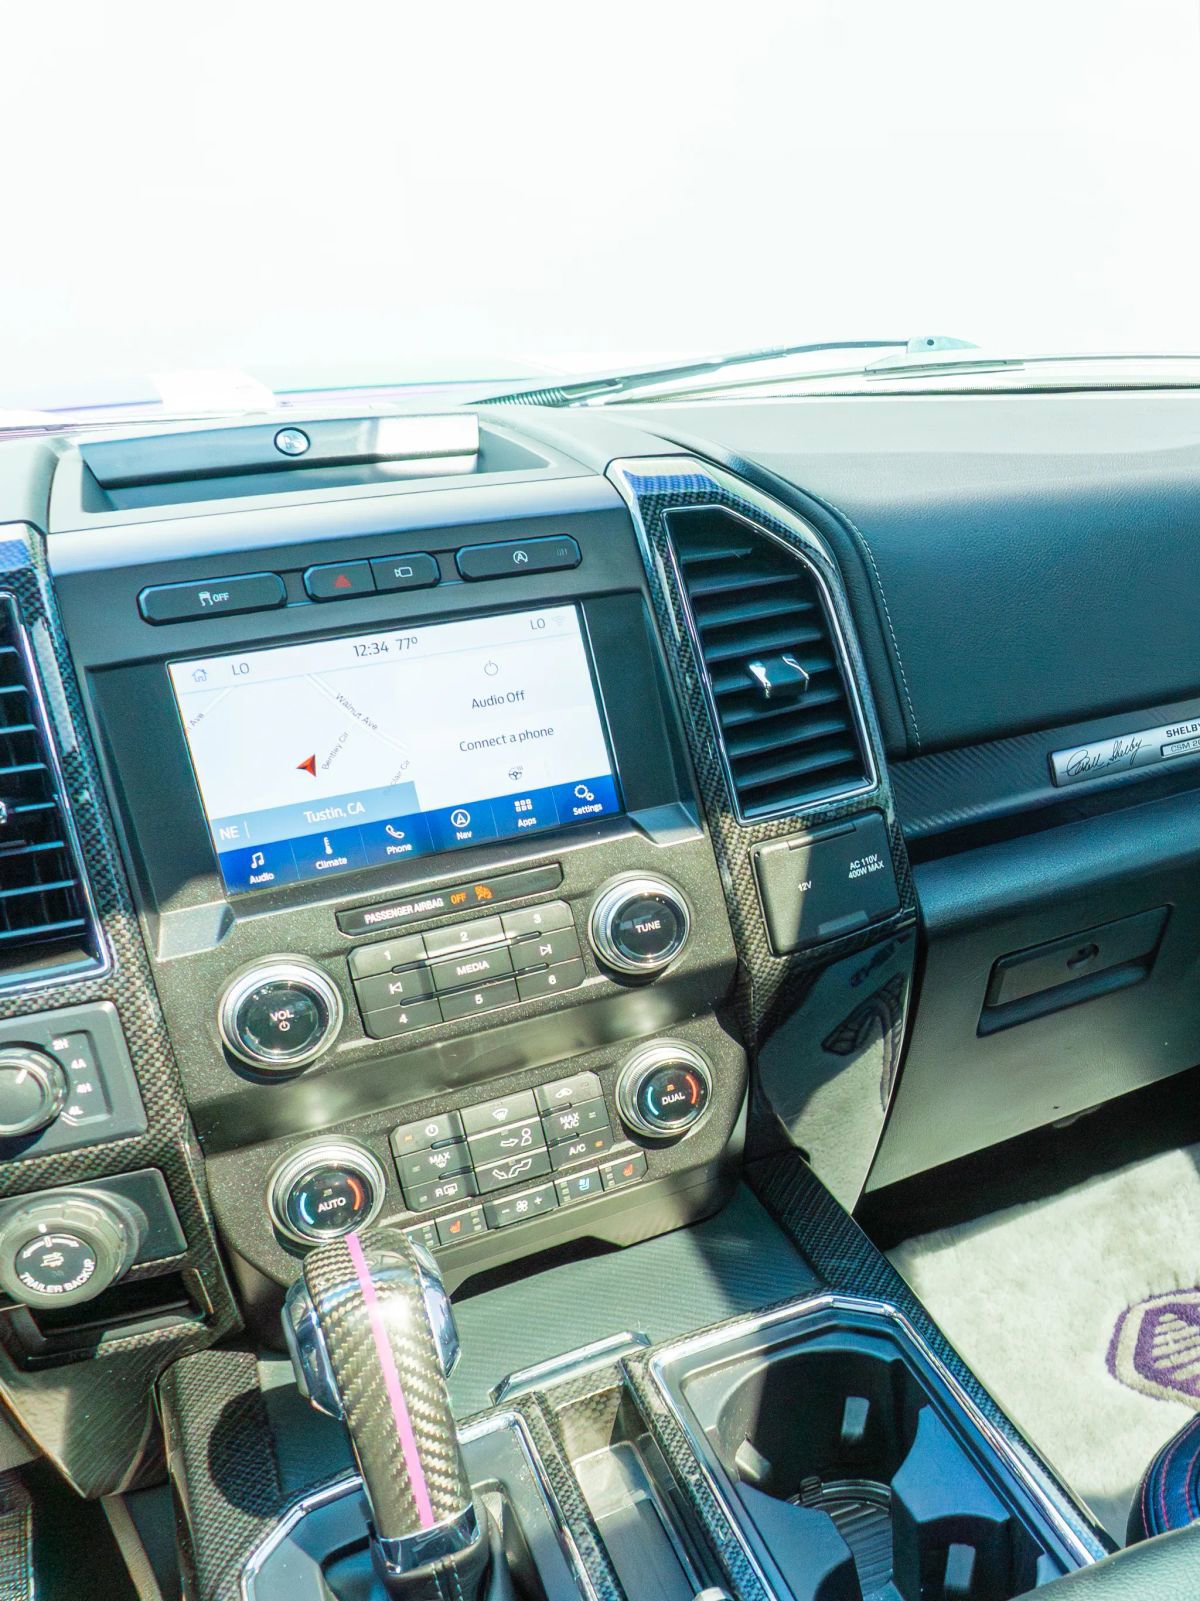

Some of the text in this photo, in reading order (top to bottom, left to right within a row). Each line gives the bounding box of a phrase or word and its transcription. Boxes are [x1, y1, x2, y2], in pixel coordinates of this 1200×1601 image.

[212, 591, 230, 602] OFF
[530, 617, 546, 631] LO
[354, 641, 389, 657] 12:34
[232, 662, 250, 676] LO
[471, 690, 526, 709] Audio Off
[335, 692, 378, 730] Walnut Ave
[459, 726, 555, 752] Connect a phone
[1170, 741, 1191, 753] CSM
[321, 743, 343, 770] Bentley
[303, 801, 366, 824] Tustin, CA
[572, 801, 603, 817] Settings
[517, 817, 537, 829] Apps
[219, 825, 240, 841] NE
[456, 830, 472, 841] Nav
[386, 843, 413, 856] Phone
[315, 856, 348, 870] Climate
[849, 853, 878, 870] AC 110V
[848, 860, 885, 879] 400W MAX
[249, 872, 275, 884] Audio
[798, 880, 812, 892] 12V
[364, 891, 467, 925] PASSENGER AIRBAG OFF
[533, 913, 542, 924] 3
[635, 920, 662, 934] TUNE
[460, 931, 469, 942] 2
[383, 950, 391, 960] 1
[456, 960, 490, 976] MEDIA
[548, 974, 557, 985] 6
[474, 994, 484, 1004] 5
[270, 1009, 295, 1022] VOL
[399, 1014, 408, 1024] 4
[661, 1092, 686, 1106] DUAL
[559, 1111, 580, 1123] MAX
[563, 1118, 580, 1129] A/C
[568, 1143, 587, 1156] A/C
[429, 1151, 451, 1164] MAX
[317, 1196, 347, 1213] AUTO
[20, 1258, 96, 1293] TRAILER BACKUP
